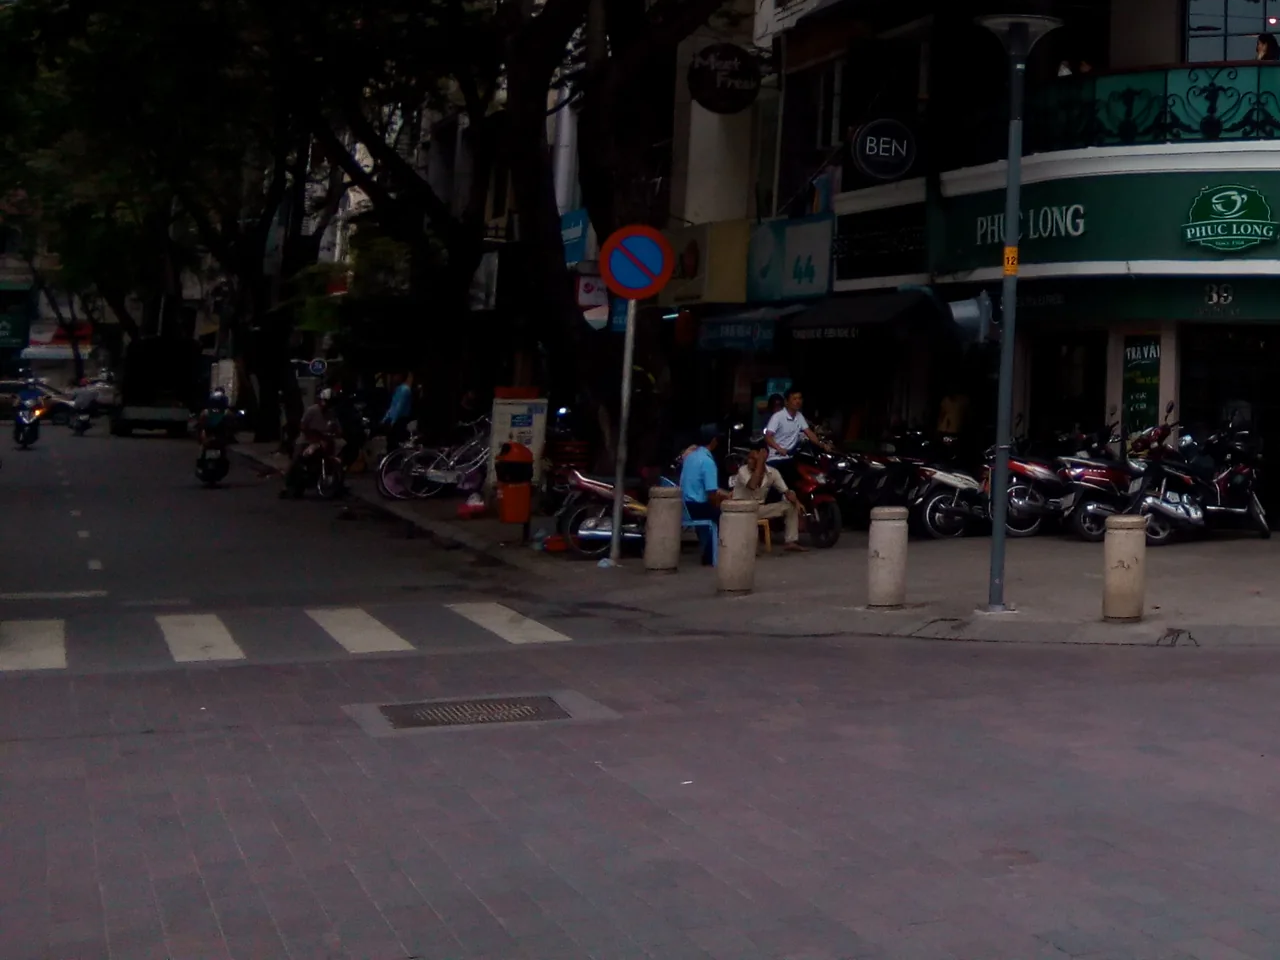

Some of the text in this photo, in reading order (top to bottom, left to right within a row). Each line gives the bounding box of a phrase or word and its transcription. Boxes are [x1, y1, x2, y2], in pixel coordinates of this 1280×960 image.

[865, 136, 909, 158] BEN
[1029, 203, 1086, 240] LONG
[1186, 222, 1275, 240] PHUC LONG
[1005, 255, 1017, 266] 12
[1203, 283, 1235, 305] 39
